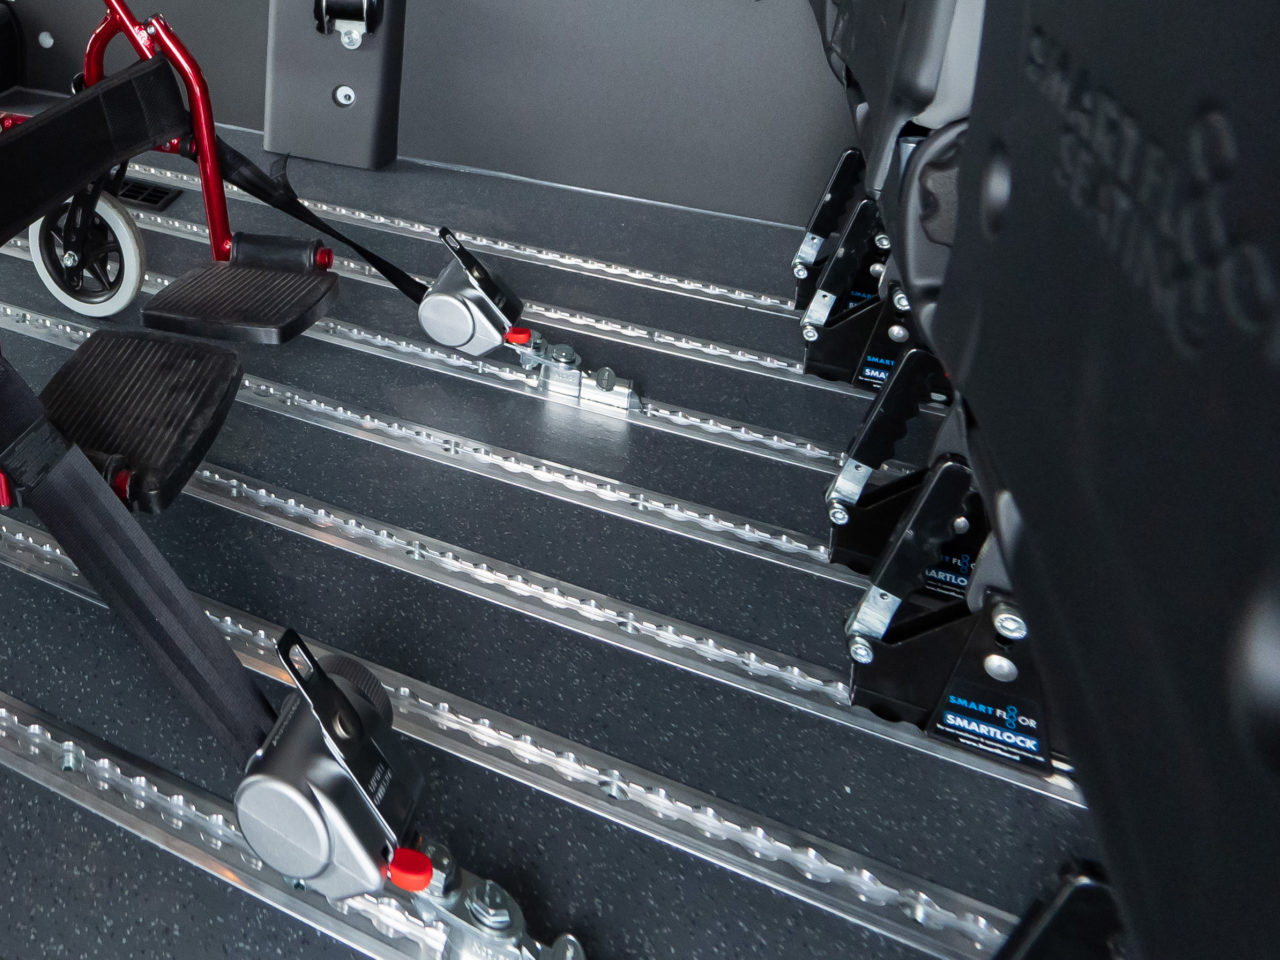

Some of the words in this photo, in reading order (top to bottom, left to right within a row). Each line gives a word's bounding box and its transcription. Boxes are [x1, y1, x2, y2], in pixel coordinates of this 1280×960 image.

[866, 355, 895, 366] SMART
[948, 695, 994, 715] SMART
[945, 713, 1037, 752] SMARTLOCK
